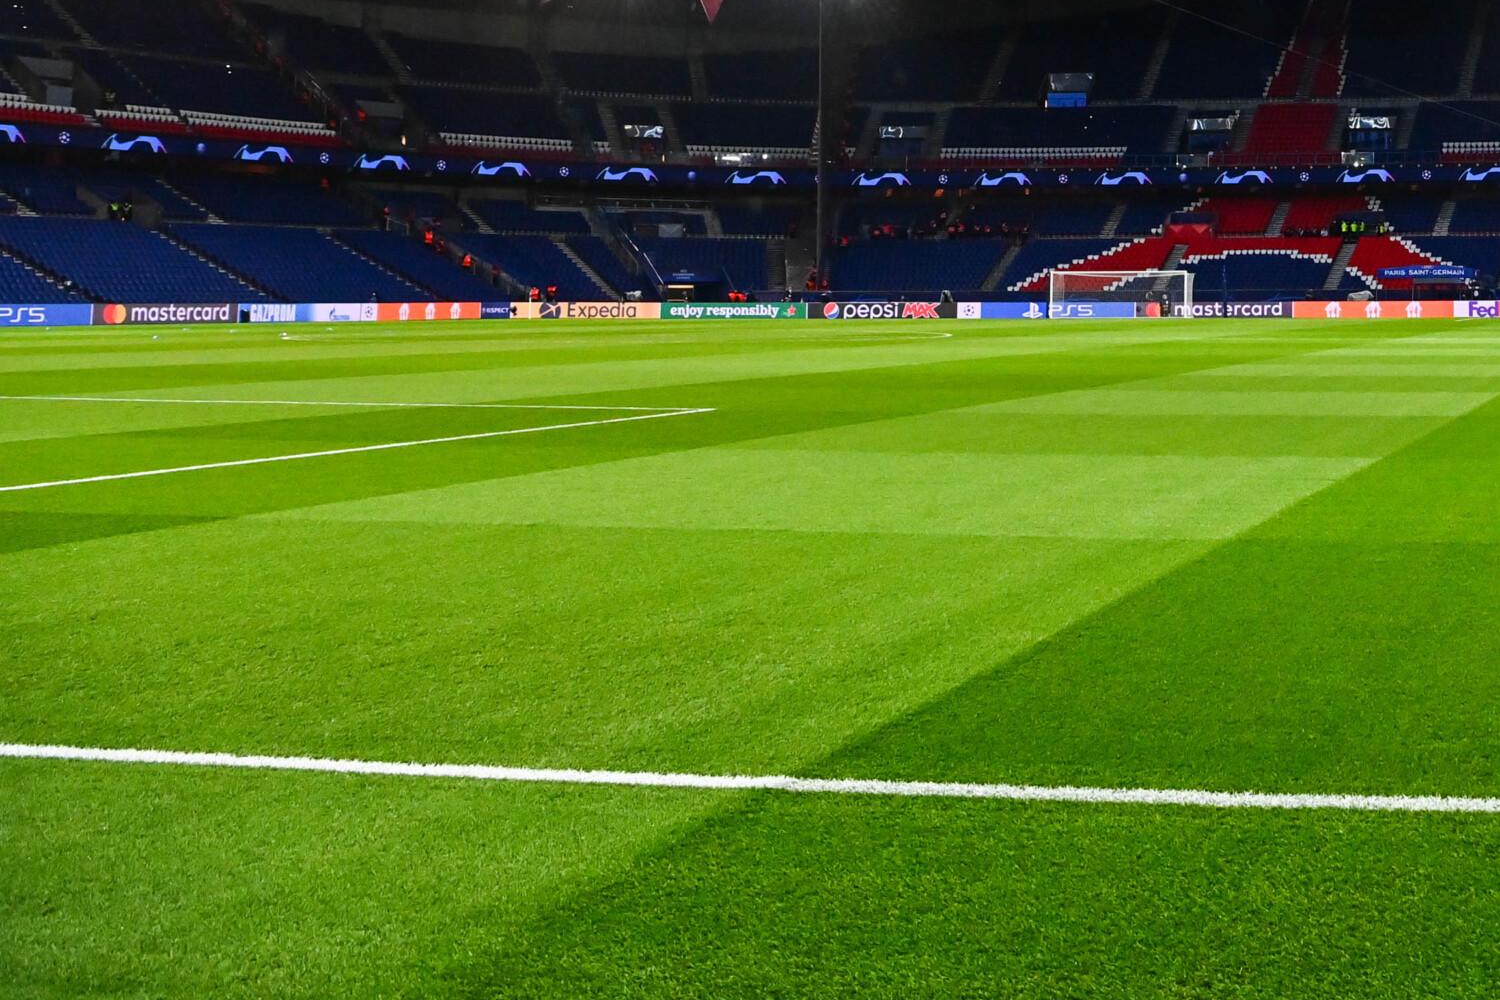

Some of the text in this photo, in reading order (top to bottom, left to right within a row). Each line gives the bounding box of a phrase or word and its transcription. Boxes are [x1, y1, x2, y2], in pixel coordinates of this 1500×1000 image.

[0, 307, 45, 322] PS5
[131, 304, 229, 321] mastercard
[250, 303, 296, 322] GAZPROM
[567, 302, 637, 319] Expedia
[670, 304, 779, 318] enjoy responsibly
[843, 302, 940, 319] pepsi MAX
[1049, 304, 1093, 316] PS5
[1174, 301, 1282, 316] mastercard
